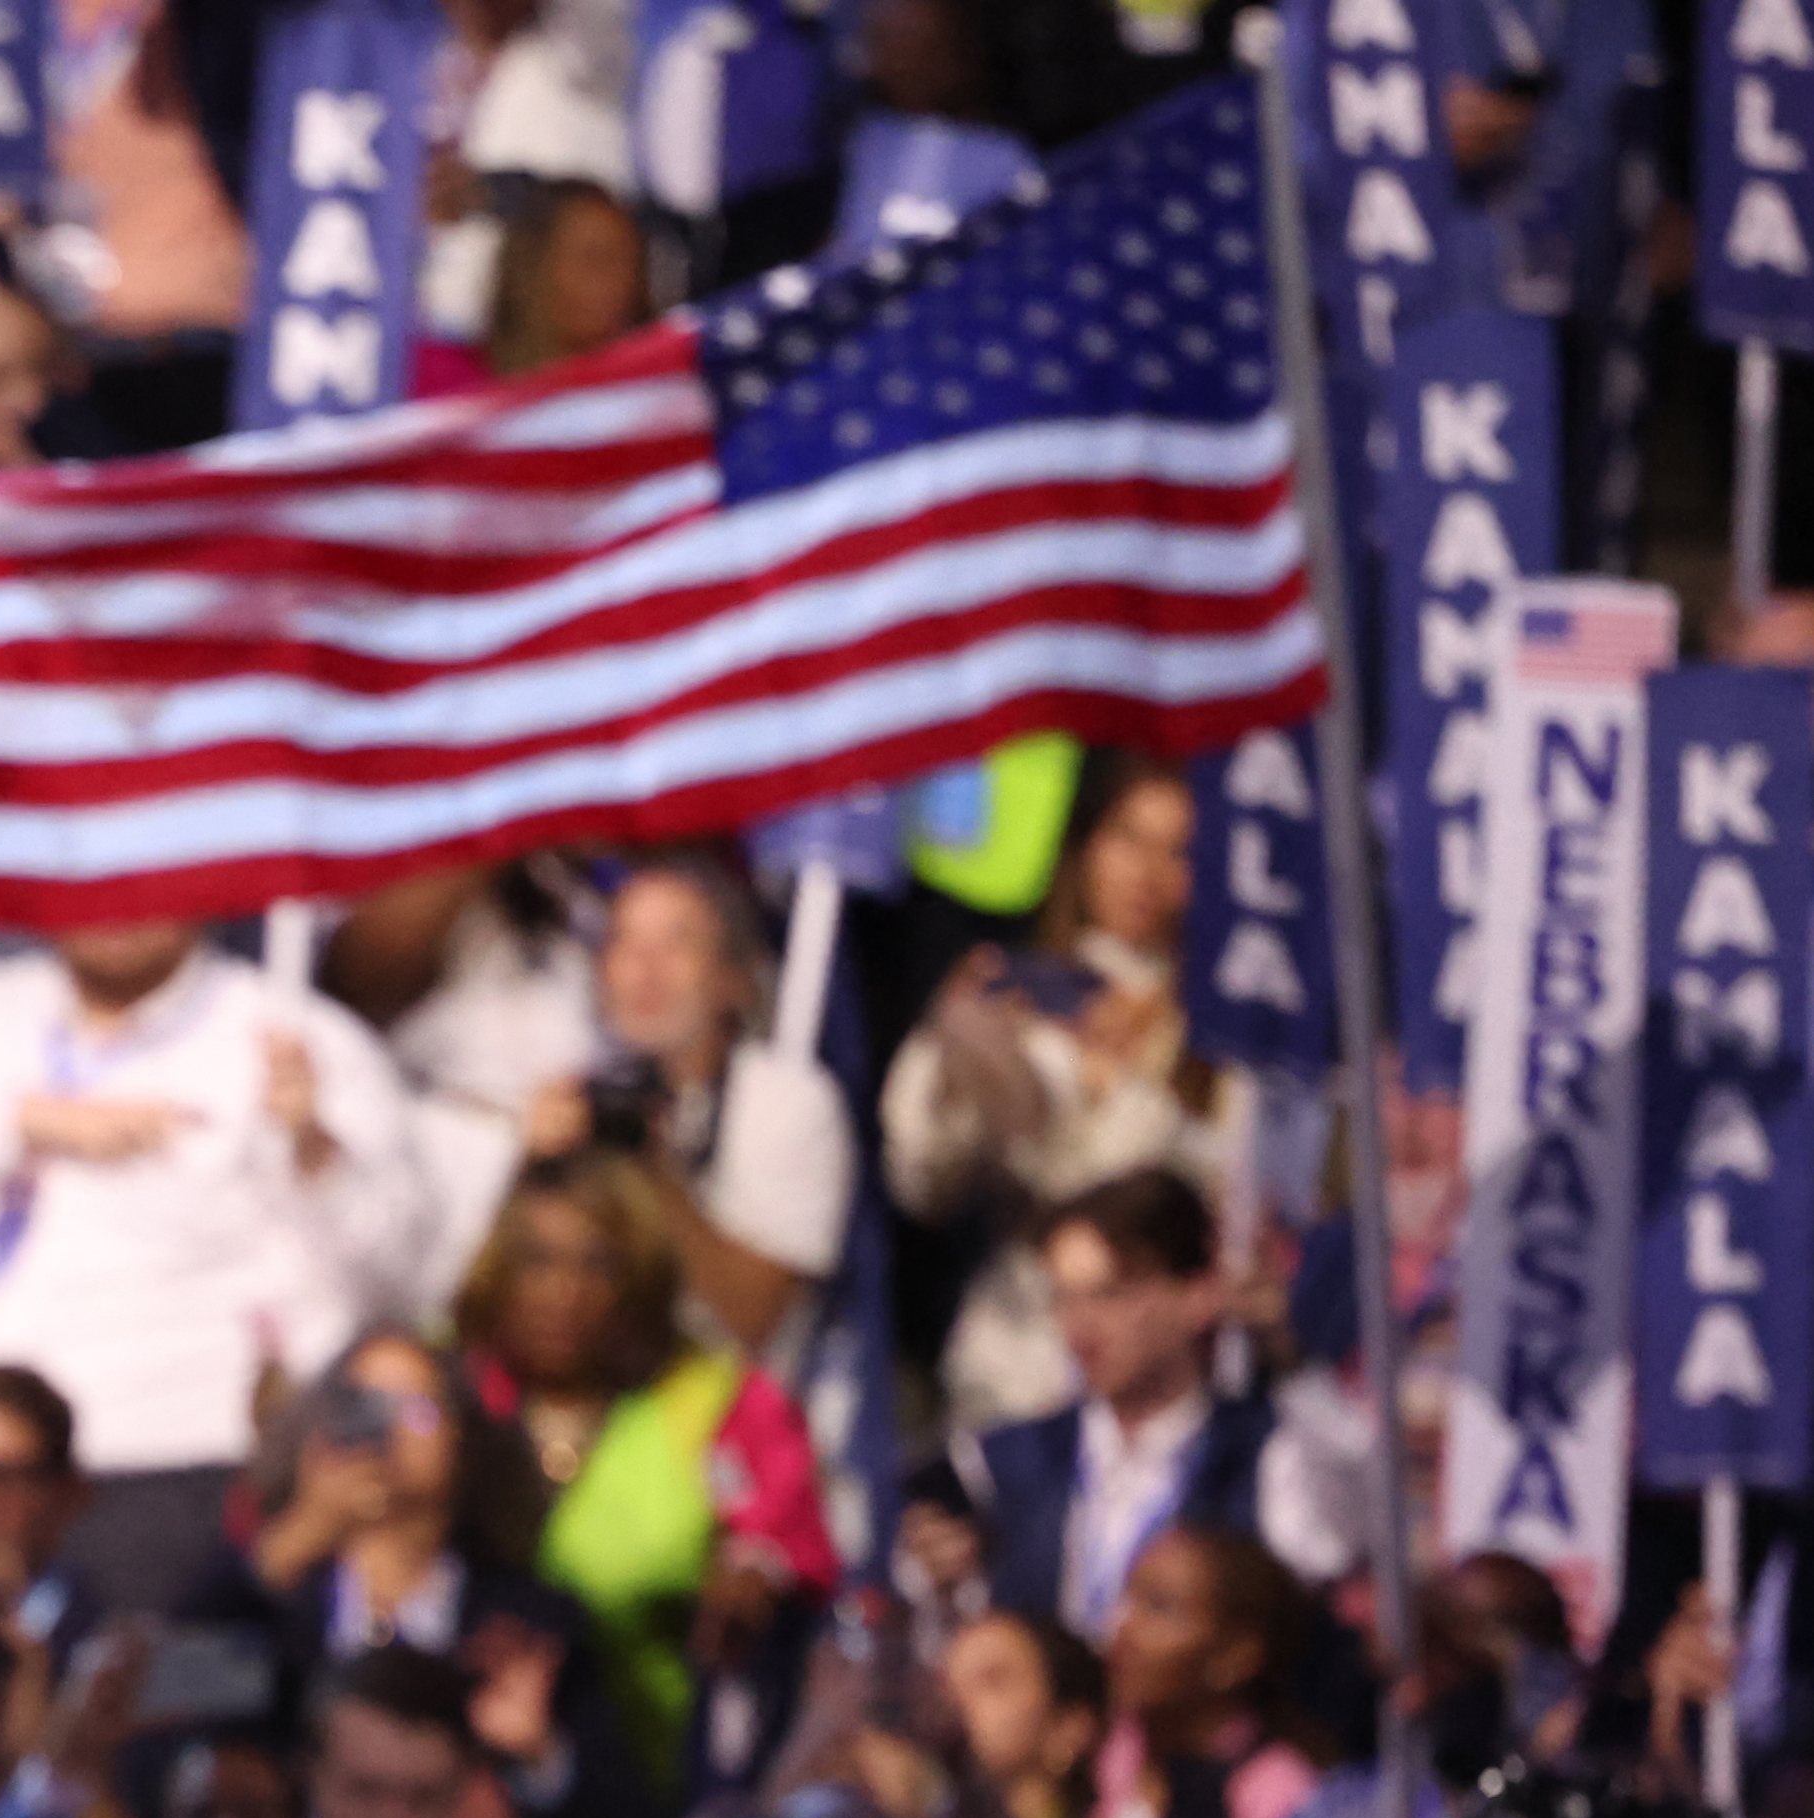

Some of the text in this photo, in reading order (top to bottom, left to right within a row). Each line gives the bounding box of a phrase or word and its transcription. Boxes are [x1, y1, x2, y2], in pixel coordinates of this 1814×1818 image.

[269, 88, 384, 405] KAM
[1492, 720, 1622, 1532] NEBRASKA
[1676, 741, 1782, 1407] KAMALA
